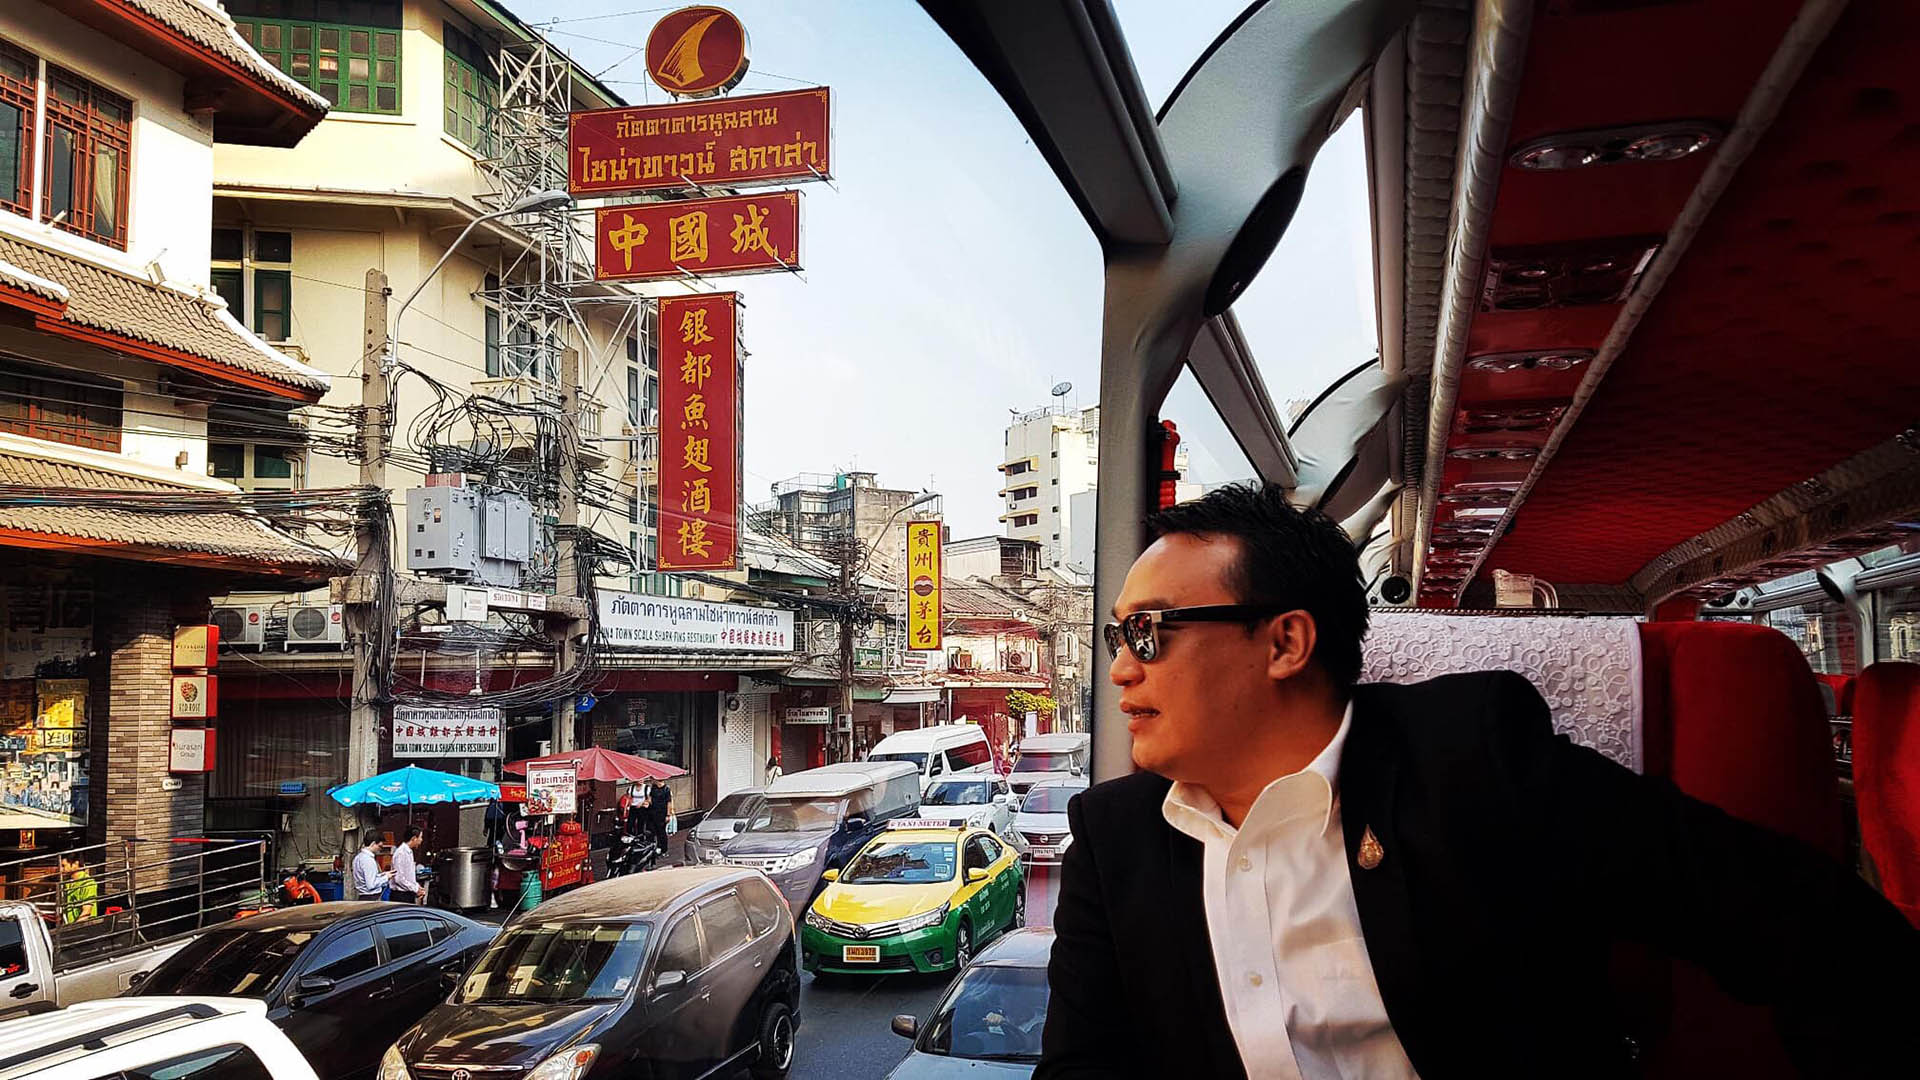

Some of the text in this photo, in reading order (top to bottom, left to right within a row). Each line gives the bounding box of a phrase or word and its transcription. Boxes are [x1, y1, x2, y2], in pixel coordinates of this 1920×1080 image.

[578, 131, 817, 183] ไชน่าทาวน์ สกาล่า
[608, 204, 778, 271] 中國城
[677, 308, 715, 559] 銀都魚翅酒樓
[615, 627, 632, 640] TOWN
[634, 629, 653, 641] SCALA
